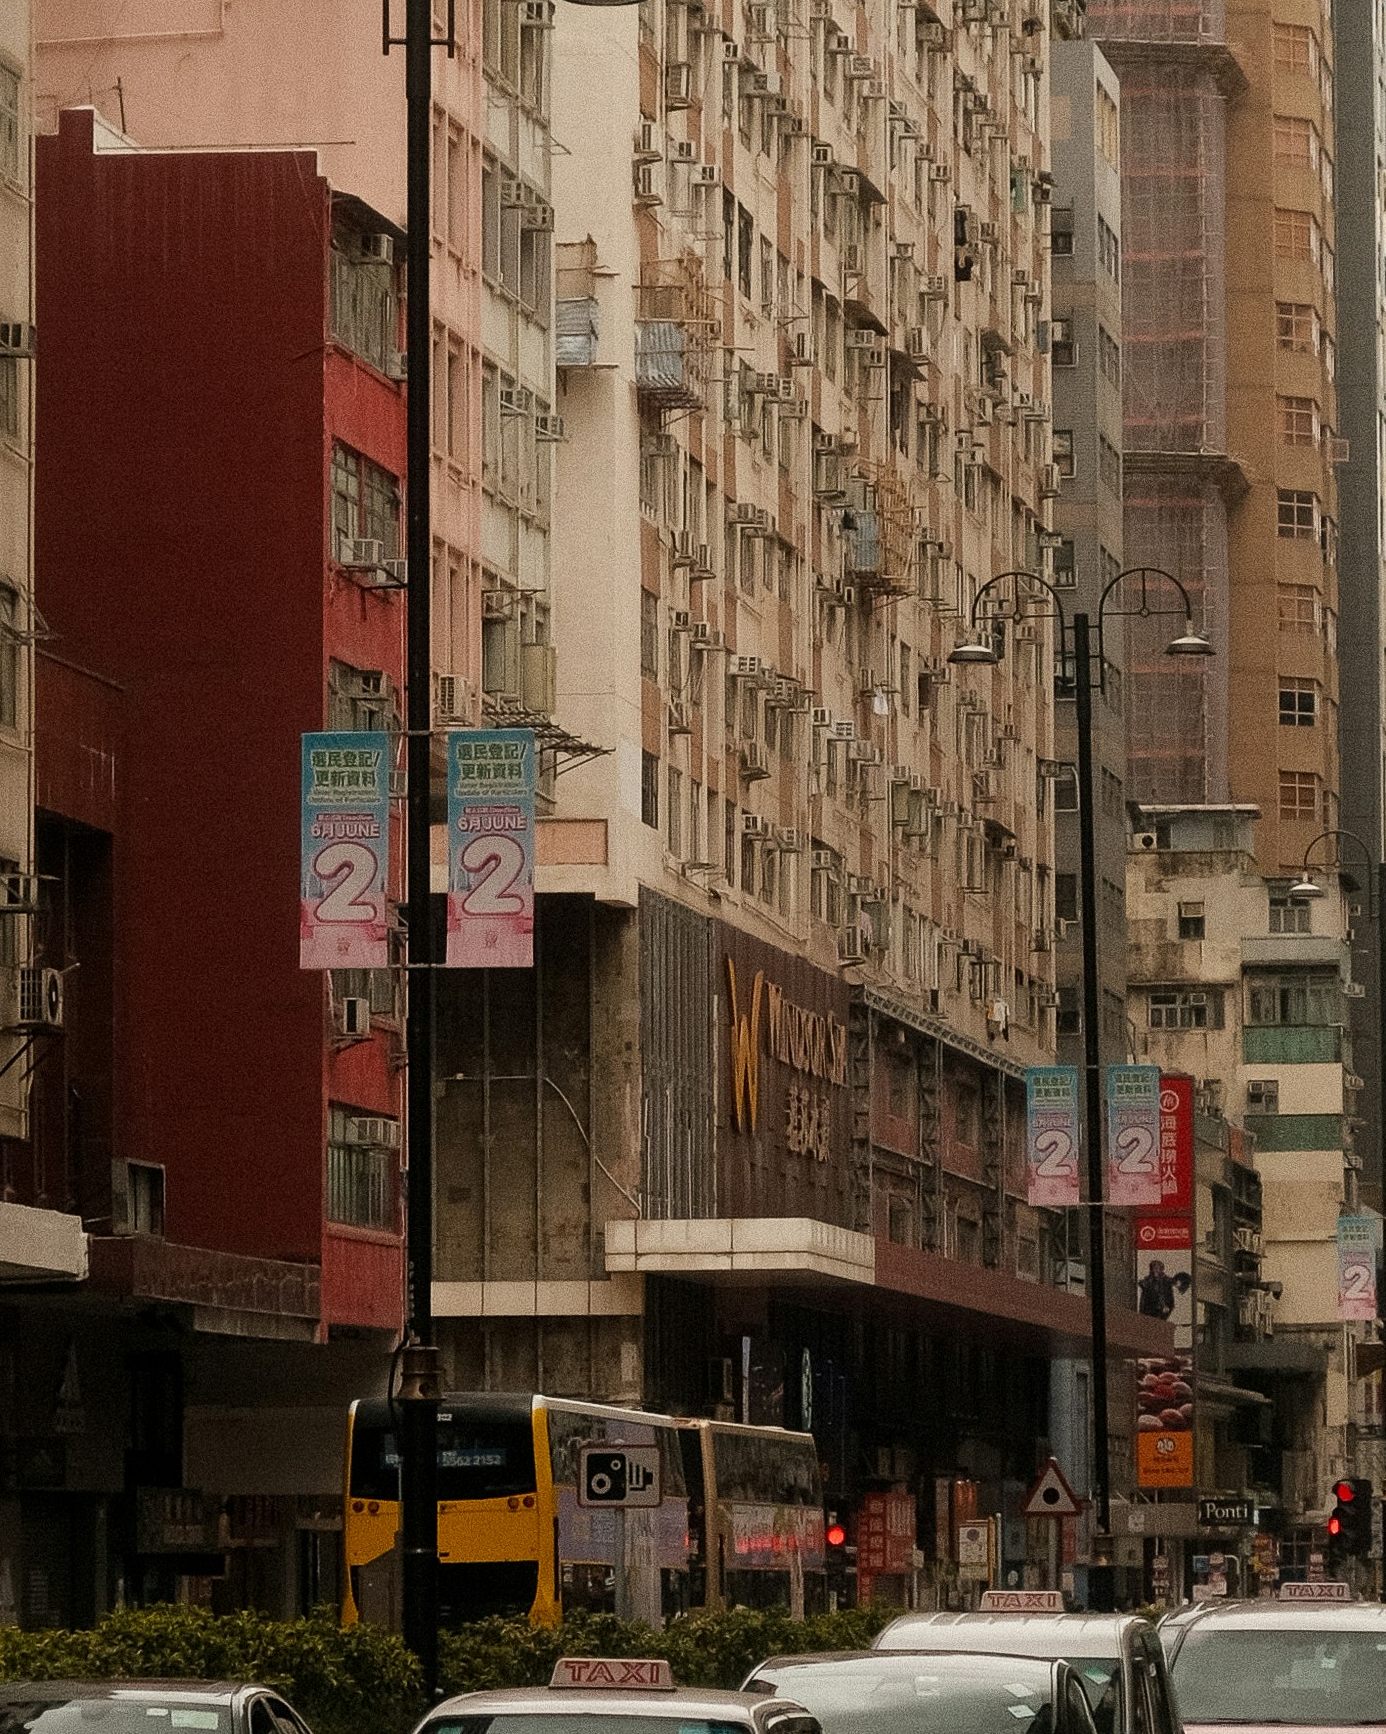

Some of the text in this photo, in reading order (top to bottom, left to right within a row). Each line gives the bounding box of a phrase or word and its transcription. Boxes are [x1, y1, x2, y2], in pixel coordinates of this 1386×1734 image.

[315, 769, 376, 788] 更新資料
[461, 762, 522, 780] 更新資料
[334, 822, 380, 839] JUNE
[482, 815, 528, 832] JUNE
[313, 841, 378, 923] 2
[461, 834, 526, 916] 2
[1034, 1128, 1072, 1177] 2
[1116, 1126, 1154, 1174] 2
[1343, 1265, 1370, 1300] 2
[1205, 1501, 1249, 1519] Ponti
[987, 1594, 1057, 1608] TAXI
[564, 1660, 660, 1684] TAXI
